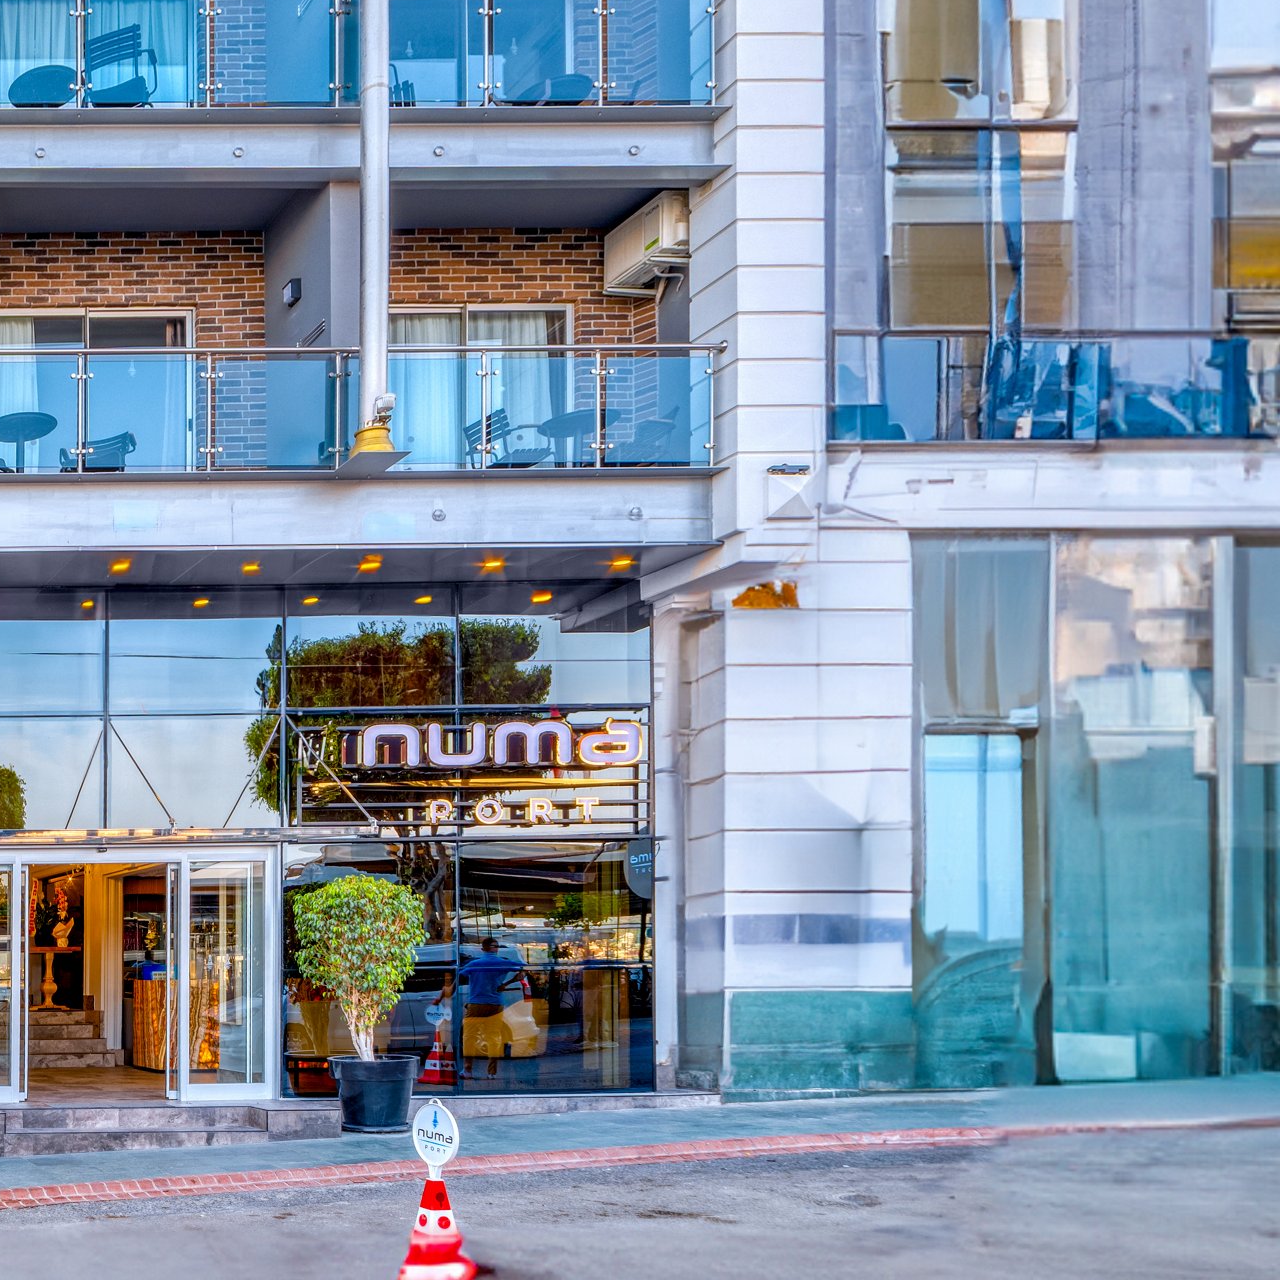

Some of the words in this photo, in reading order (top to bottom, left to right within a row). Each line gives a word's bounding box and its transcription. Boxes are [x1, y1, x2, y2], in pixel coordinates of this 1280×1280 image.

[361, 718, 643, 768] numa
[428, 796, 600, 825] PORT
[417, 1129, 453, 1144] numa
[424, 1145, 446, 1154] PORT
